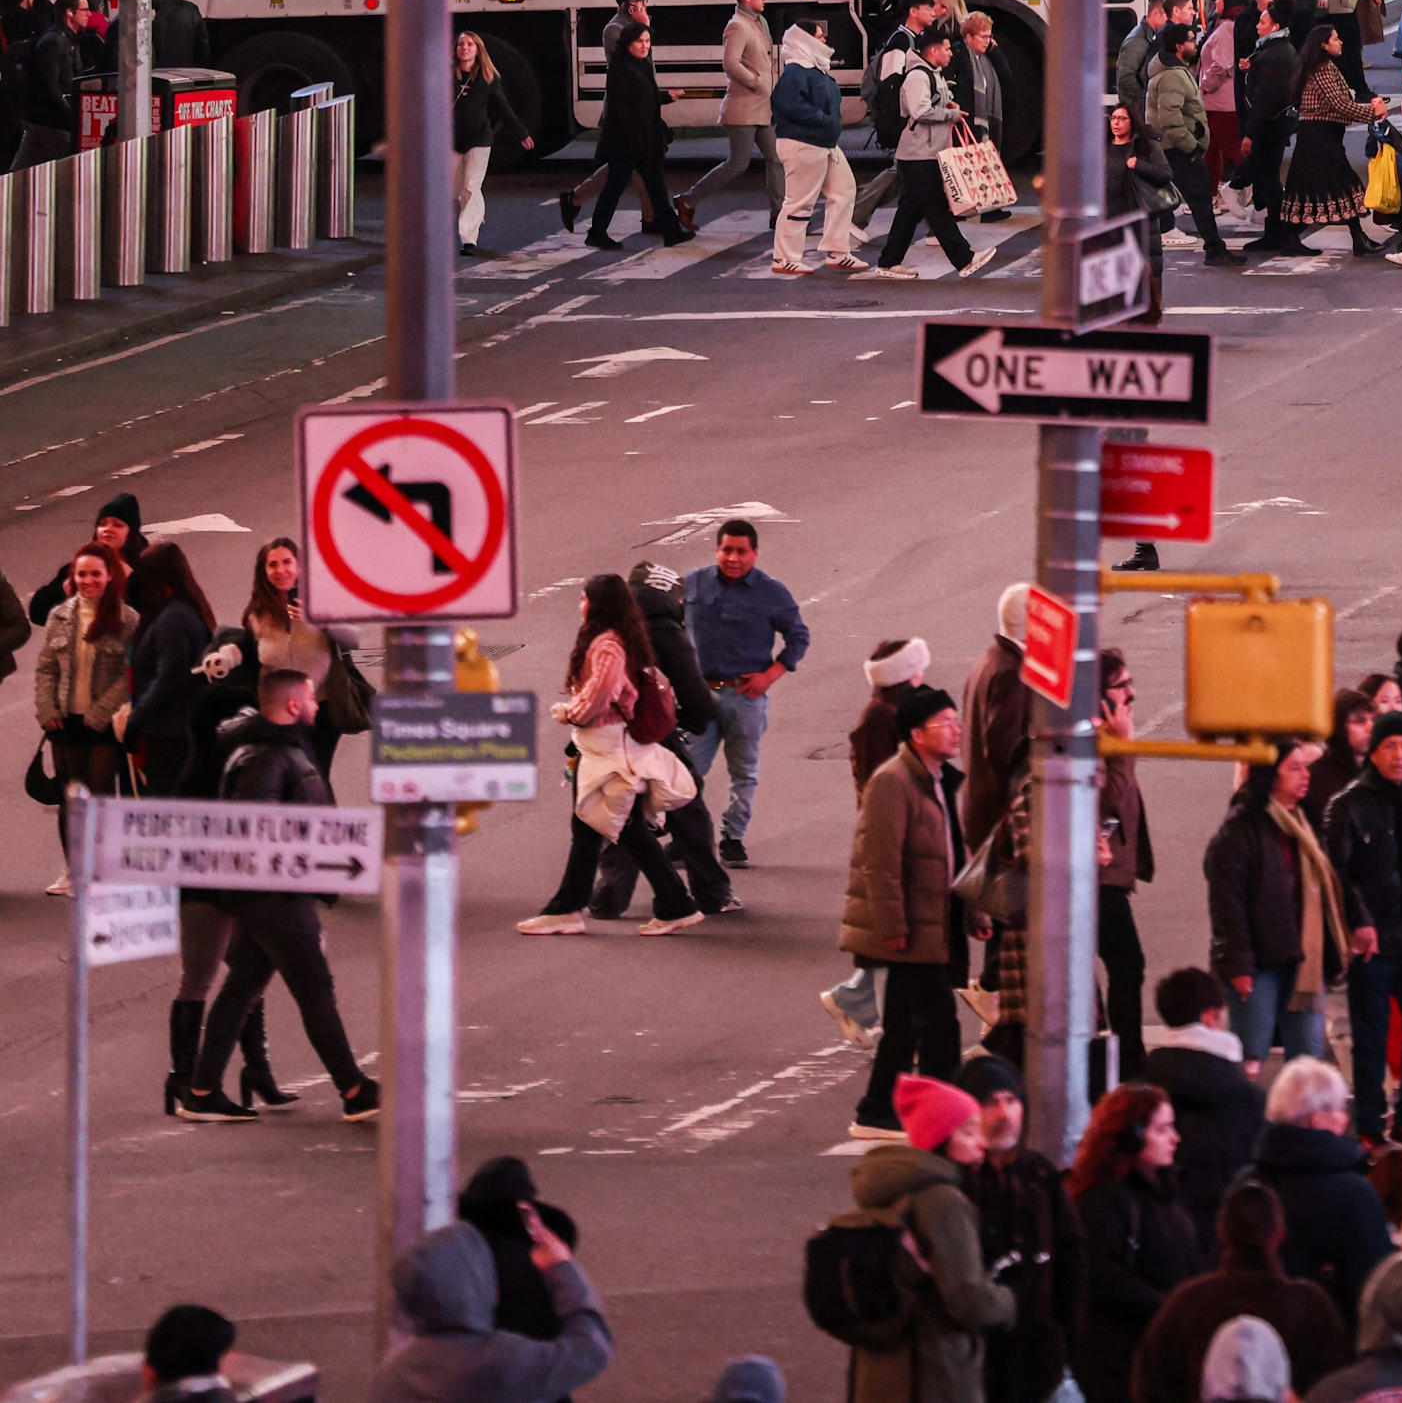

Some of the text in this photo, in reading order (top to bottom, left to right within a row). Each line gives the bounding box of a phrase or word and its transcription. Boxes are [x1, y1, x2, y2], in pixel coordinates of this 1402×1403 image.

[82, 96, 118, 112] BEAT
[191, 101, 204, 119] THE
[82, 112, 117, 137] IT
[965, 353, 1174, 395] ONE WAY
[380, 717, 511, 742] Times Square
[378, 744, 475, 760] Pedestrian
[122, 811, 371, 848] PEDESTRIAN FLOW ZONE
[121, 845, 256, 876] KEEP MOVING
